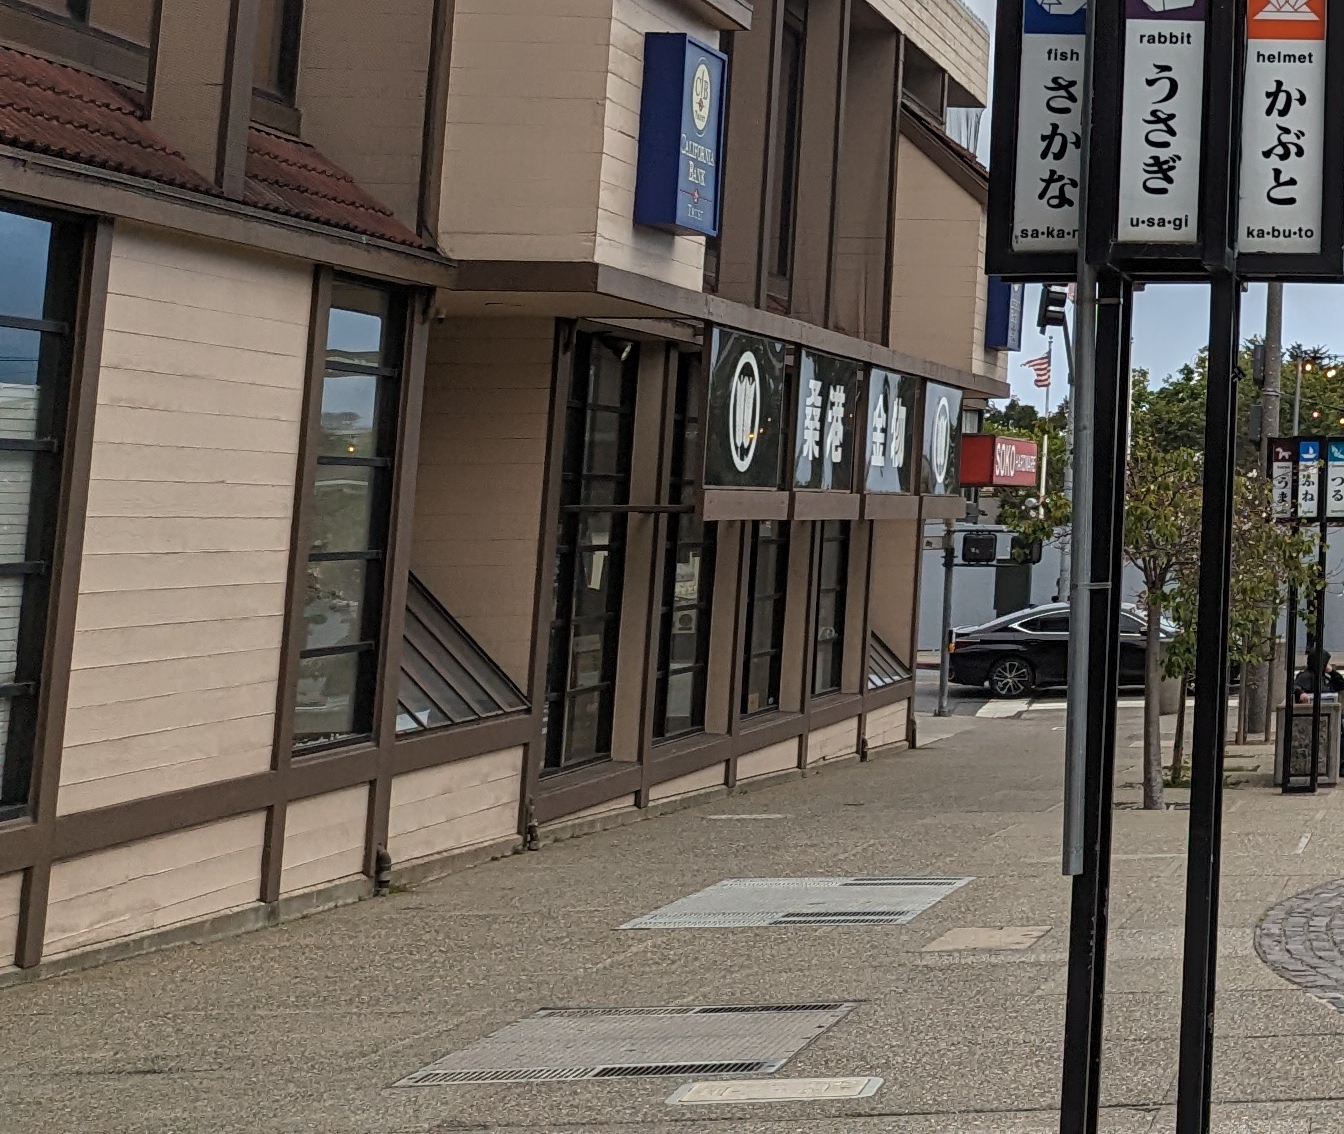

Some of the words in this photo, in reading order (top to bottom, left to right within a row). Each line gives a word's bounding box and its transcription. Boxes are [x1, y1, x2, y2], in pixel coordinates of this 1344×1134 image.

[1139, 32, 1192, 46] rabbit
[1046, 48, 1080, 62] fish
[1256, 50, 1314, 65] helmet
[1037, 75, 1081, 209] さかな
[1141, 62, 1182, 195] うさぎ
[1261, 79, 1307, 206] かぶと
[681, 133, 715, 167] CALIFORNIA
[688, 160, 706, 187] BANK
[995, 443, 1016, 477] SOKO
[1330, 476, 1344, 502] つる
